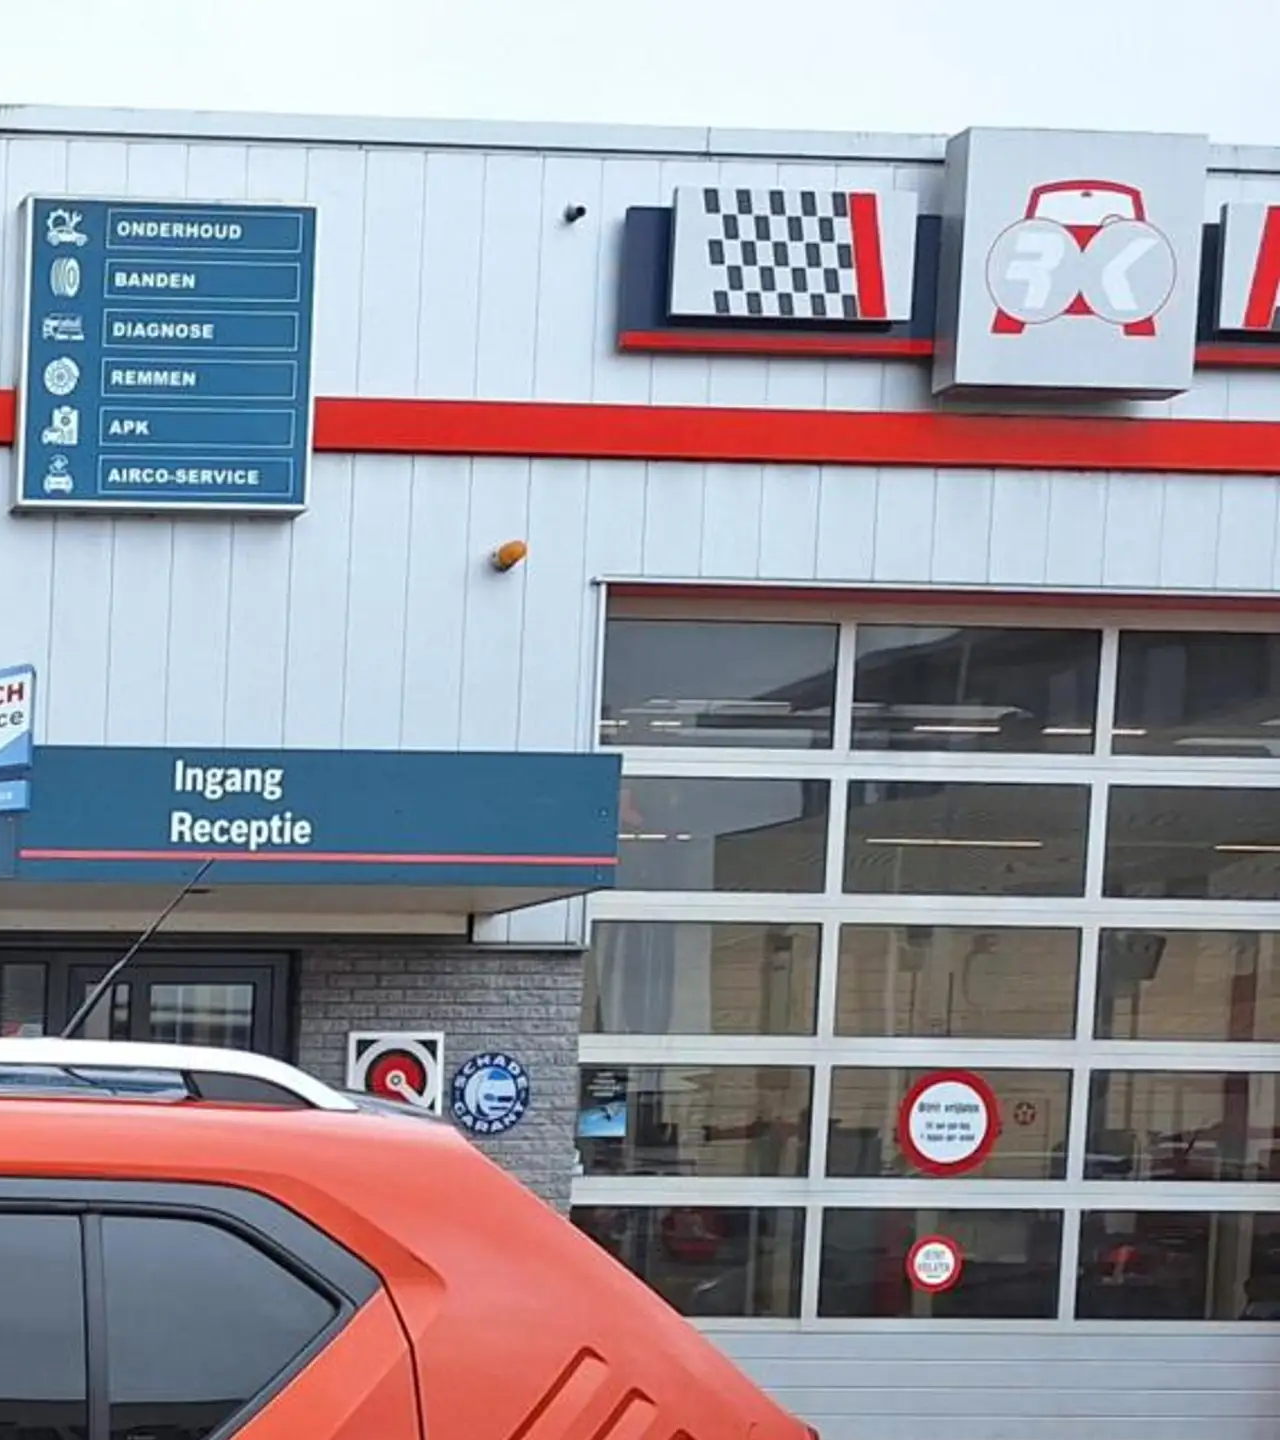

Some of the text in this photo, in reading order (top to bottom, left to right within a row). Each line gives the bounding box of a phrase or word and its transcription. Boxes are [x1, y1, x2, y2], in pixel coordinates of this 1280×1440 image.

[116, 220, 243, 241] ONDERHOUD
[113, 271, 197, 290] BANDEN
[112, 322, 215, 340] DIAGNOSE
[110, 370, 197, 388] REMMEN
[108, 419, 150, 436] APK
[107, 467, 260, 486] AIRCO-SERVICE
[174, 759, 284, 801] Ingang
[169, 811, 312, 851] Receptie
